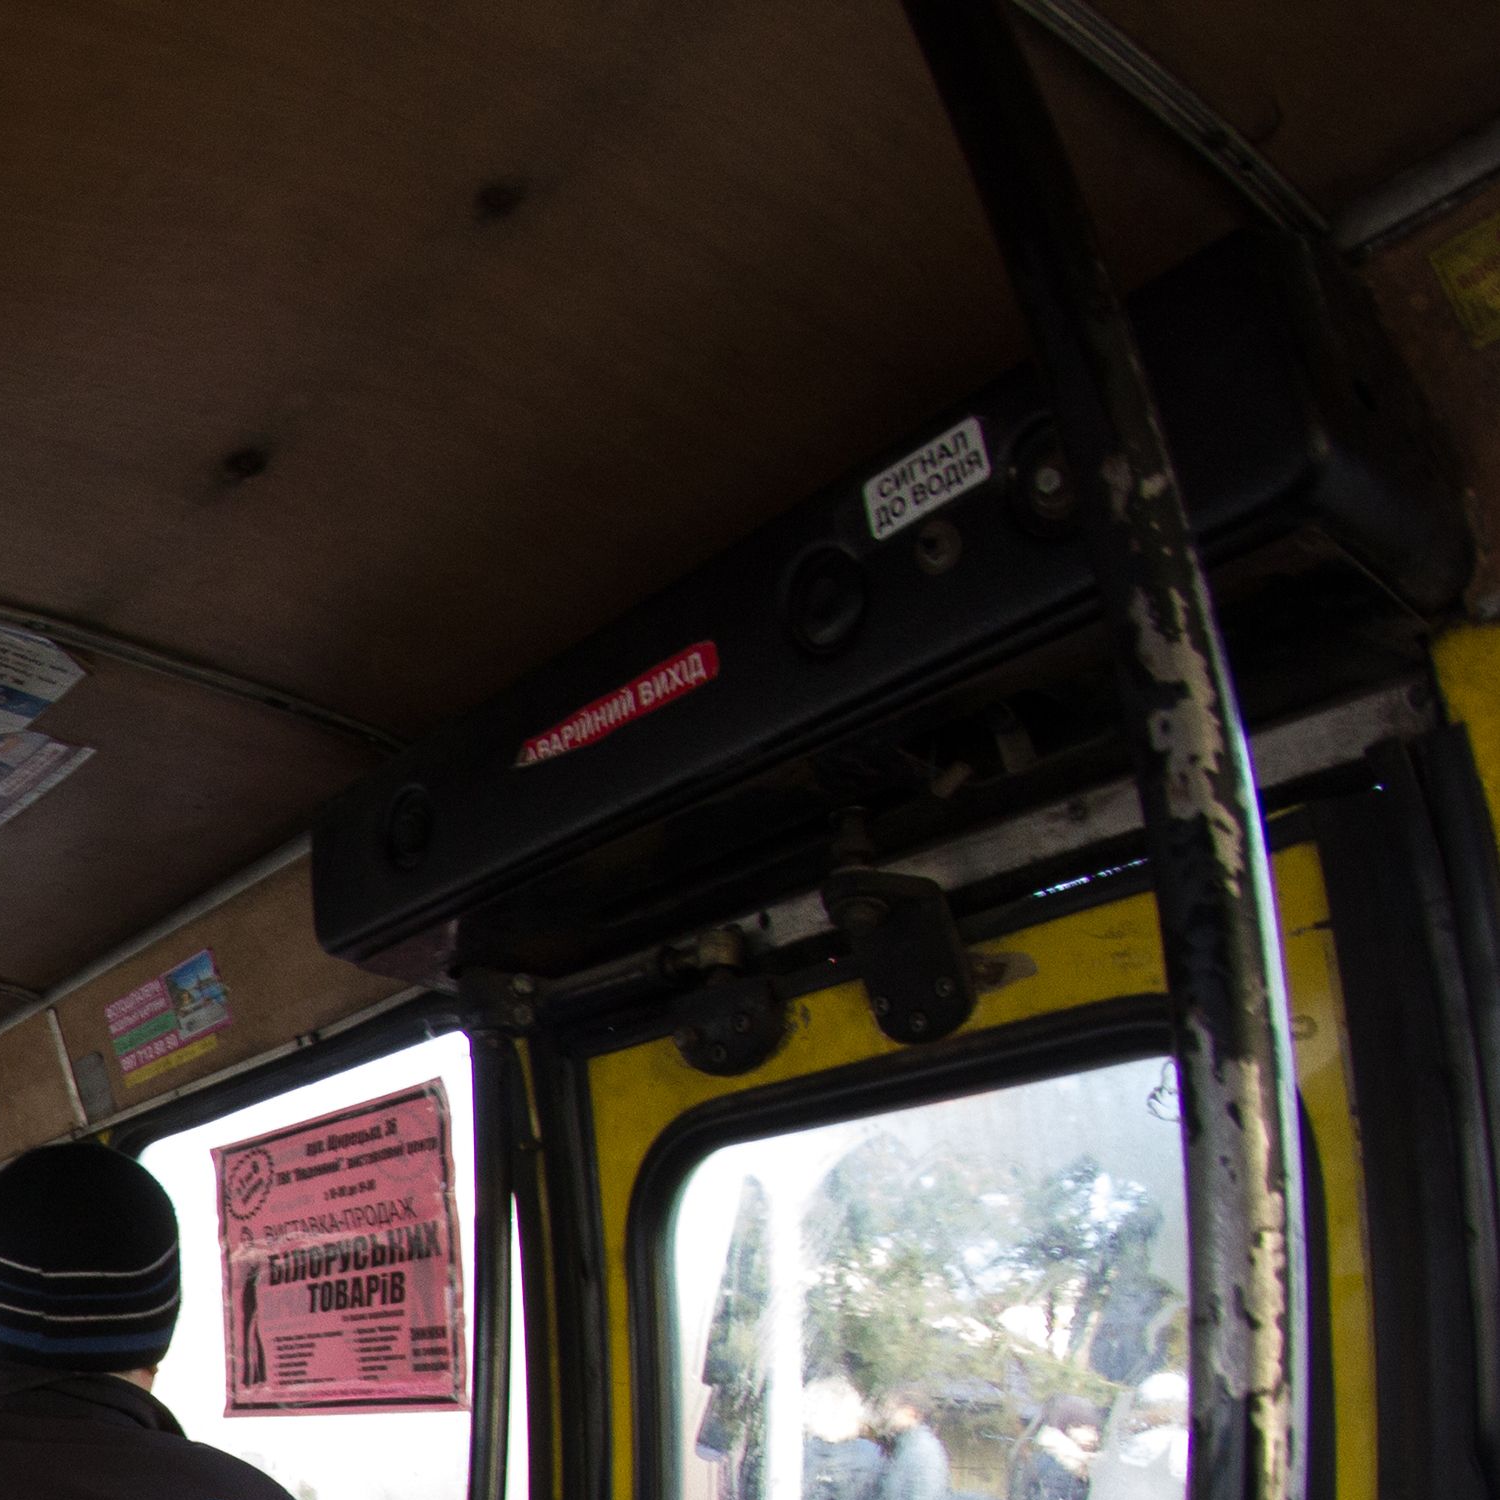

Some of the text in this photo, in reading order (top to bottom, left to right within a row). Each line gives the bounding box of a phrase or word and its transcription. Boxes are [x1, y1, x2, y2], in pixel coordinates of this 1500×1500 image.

[876, 450, 983, 533] ДО ВОДІЯ
[879, 431, 969, 497] СИГНАЛ
[524, 651, 708, 763] АВАРІЙНИЙ ВИХІД
[263, 1197, 418, 1243] ВИСТАВКА-ПРОДАЖ
